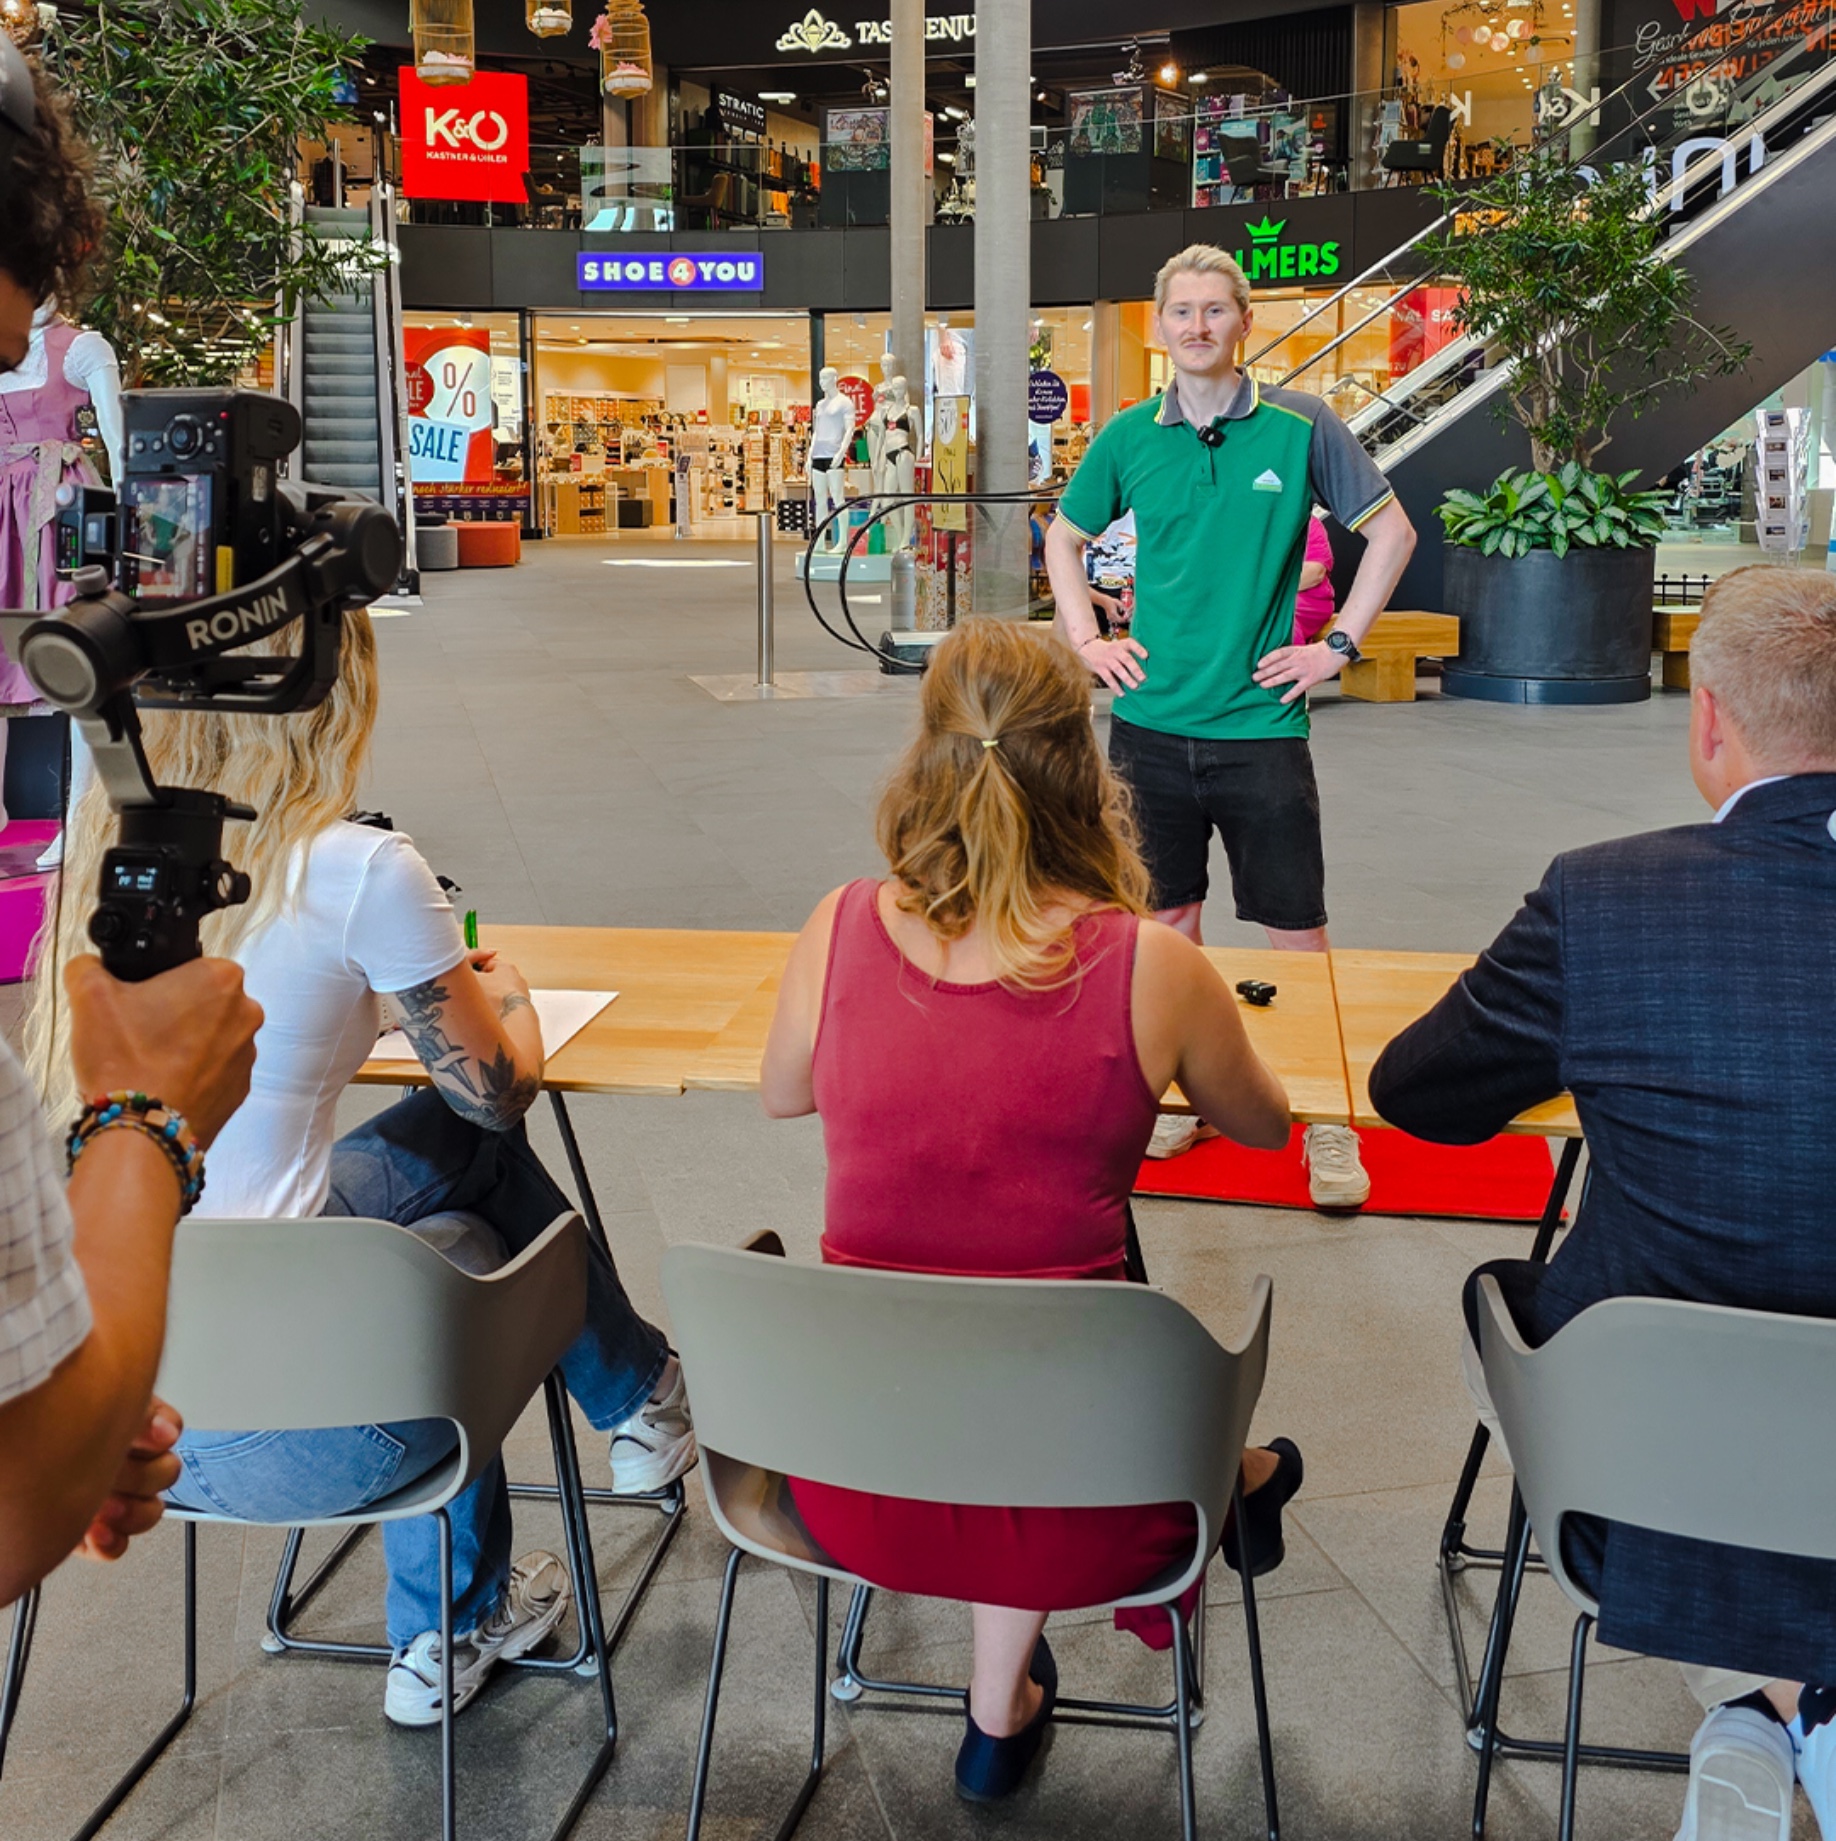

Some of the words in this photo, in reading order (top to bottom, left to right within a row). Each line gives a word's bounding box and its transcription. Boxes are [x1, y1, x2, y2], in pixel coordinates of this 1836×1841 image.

[855, 14, 976, 44] TASENJU
[719, 93, 764, 119] STRATIC
[1235, 241, 1340, 280] LMERS
[408, 380, 424, 400] LE
[409, 423, 463, 463] SALE
[185, 586, 288, 650] RONIN
